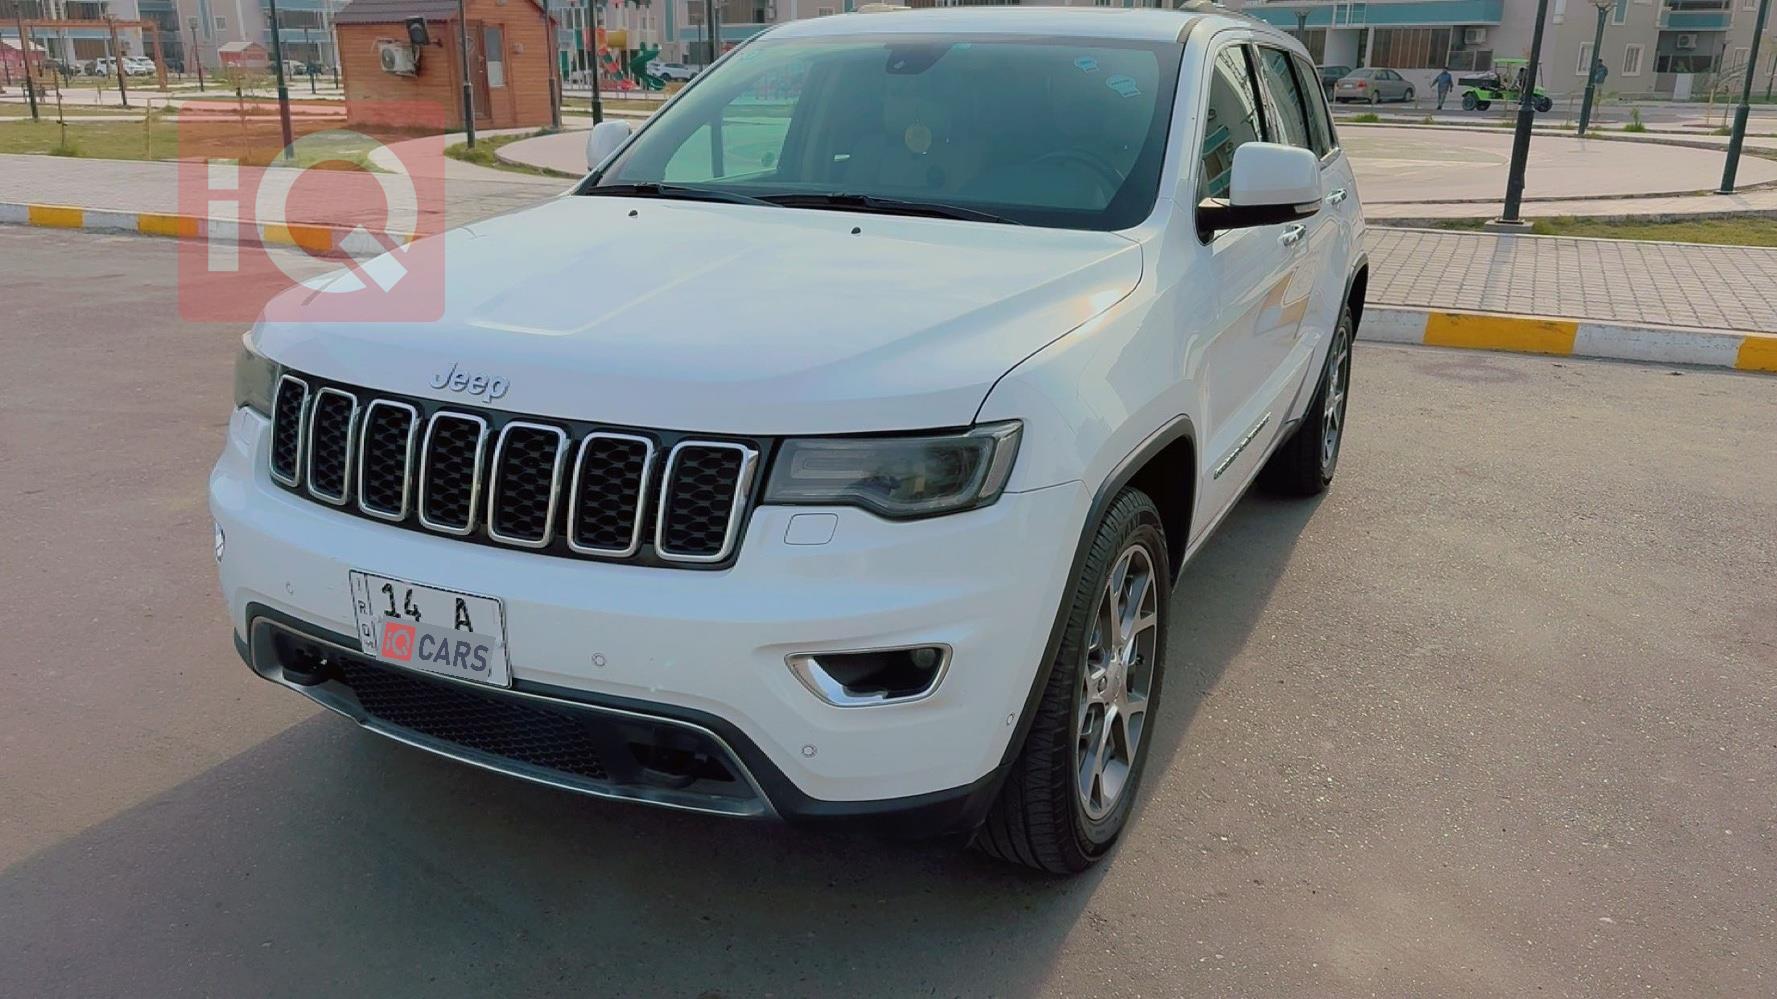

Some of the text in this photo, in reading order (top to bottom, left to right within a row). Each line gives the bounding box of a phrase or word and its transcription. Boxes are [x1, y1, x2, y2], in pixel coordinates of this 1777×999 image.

[430, 361, 511, 403] Jeep
[382, 583, 473, 632] 14 A
